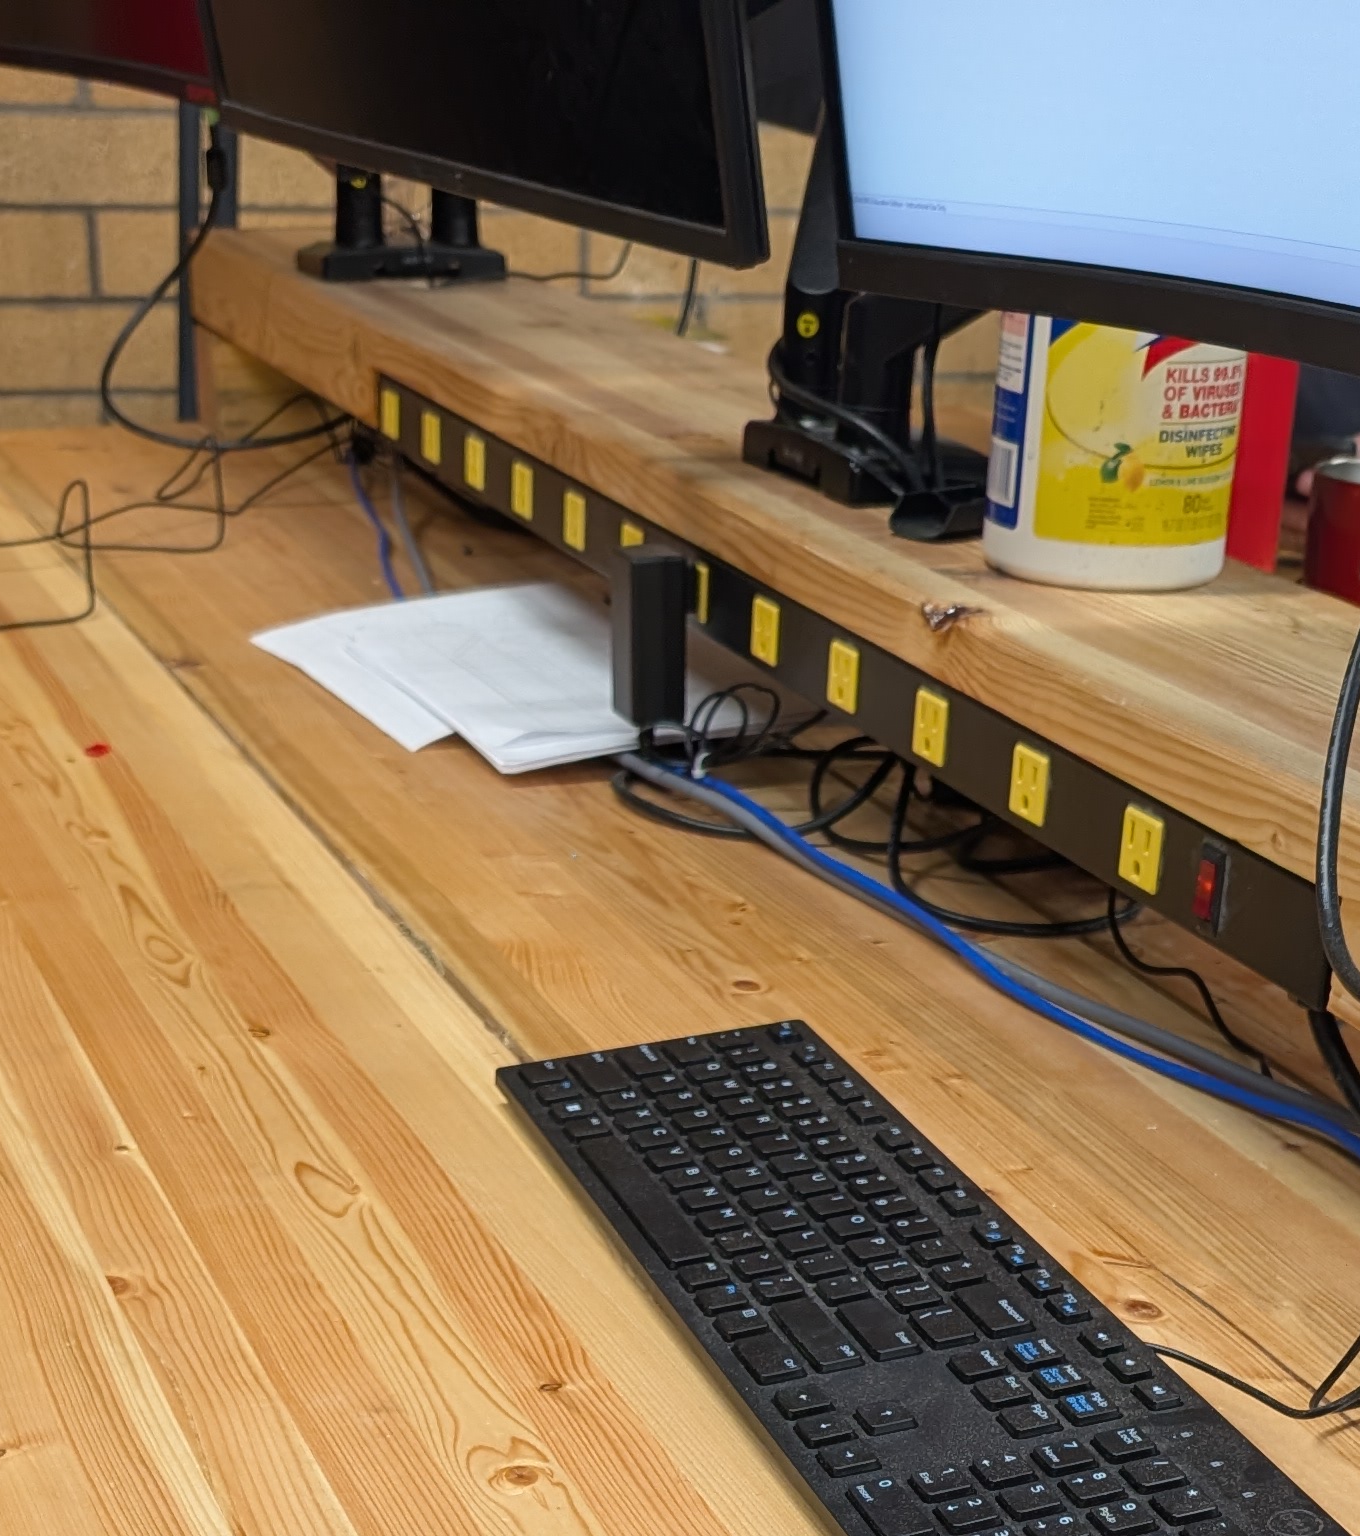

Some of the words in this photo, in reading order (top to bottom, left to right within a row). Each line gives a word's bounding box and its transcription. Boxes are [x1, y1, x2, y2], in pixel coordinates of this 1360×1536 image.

[1166, 367, 1210, 383] KILLS
[1164, 386, 1187, 402] OF
[1162, 404, 1173, 419] &
[1185, 444, 1223, 458] WIPES
[746, 1168, 760, 1176] H
[812, 1173, 826, 1181] U
[703, 1187, 718, 1196] N
[721, 1208, 736, 1217] M
[783, 1209, 797, 1217] K
[851, 1215, 865, 1223] O
[802, 1231, 814, 1239] L
[998, 1300, 1024, 1322] Backspace
[1038, 1339, 1055, 1354] Insert
[981, 1350, 998, 1366] Delete
[1041, 1370, 1056, 1383] Lock
[1049, 1368, 1068, 1384] Scroll
[1064, 1365, 1081, 1380] Home
[1005, 1376, 1020, 1388] End
[1076, 1395, 1094, 1411] Pause
[1091, 1392, 1107, 1407] PgUp
[1031, 1404, 1048, 1419] PgDn
[1117, 1430, 1133, 1444] Lock
[1127, 1428, 1142, 1442] Num
[1042, 1446, 1059, 1462] Home
[919, 1472, 933, 1483] End
[941, 1468, 954, 1476] 1
[1093, 1472, 1106, 1480] 8
[856, 1485, 873, 1502] Insert
[1099, 1507, 1116, 1523] PgUp
